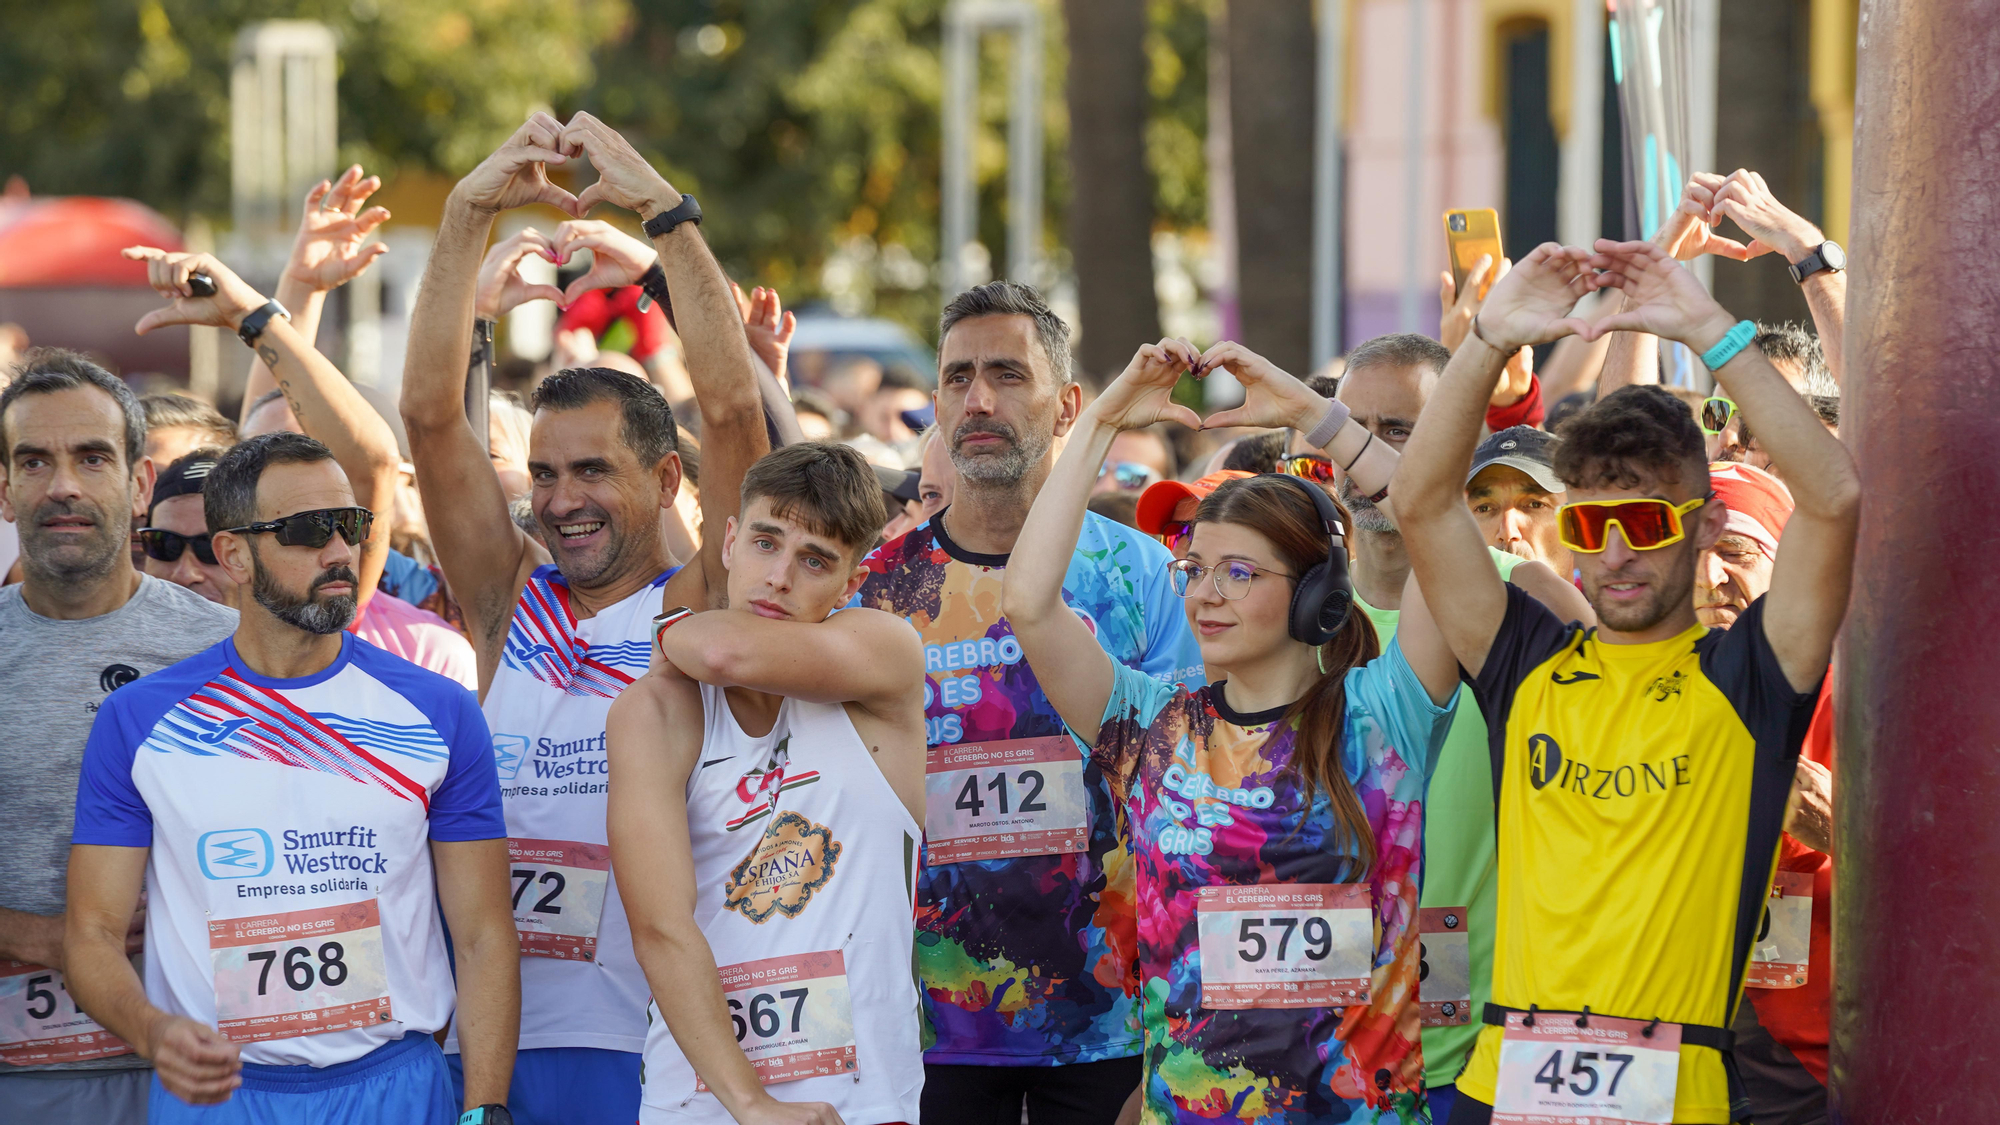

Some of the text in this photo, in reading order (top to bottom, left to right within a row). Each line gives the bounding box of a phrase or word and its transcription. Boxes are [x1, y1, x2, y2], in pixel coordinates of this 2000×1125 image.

[943, 677, 980, 704] ES
[949, 745, 983, 756] CARRERA
[953, 752, 989, 763] CEREBRO
[990, 752, 1003, 760] NO
[1004, 750, 1015, 758] ES
[1016, 748, 1035, 757] GRIS
[1529, 735, 1691, 800] AIRZONE
[955, 770, 1046, 817] 412
[1196, 803, 1235, 826] ES
[283, 825, 377, 851] Smurfit
[779, 839, 803, 848] JAMONES
[954, 837, 976, 845] SERVIER
[1158, 827, 1214, 855] GRIS
[546, 850, 564, 858] GRIS
[284, 851, 388, 875] Westrock
[737, 848, 815, 886] ESPAÑA
[236, 878, 368, 901] Empresa solidaria
[1232, 887, 1270, 895] CARRERA
[1237, 895, 1275, 903] CEREBRO
[1304, 894, 1324, 902] GRIS
[235, 930, 245, 938] EL
[246, 925, 285, 937] CEREBRO
[287, 923, 301, 932] NO
[302, 921, 314, 930] ES
[315, 919, 335, 928] GRIS
[241, 918, 279, 929] CARRERA
[1238, 916, 1332, 962] 579
[247, 941, 348, 996] 768
[752, 971, 764, 980] NO
[766, 969, 777, 978] ES
[778, 965, 798, 975] GRIS
[250, 1017, 274, 1025] SERVIER
[1539, 1018, 1575, 1027] CARRERA
[1532, 1026, 1628, 1039] EL CEREBRO NO ES GRIS
[768, 1058, 784, 1067] bida
[1535, 1049, 1635, 1097] 457
